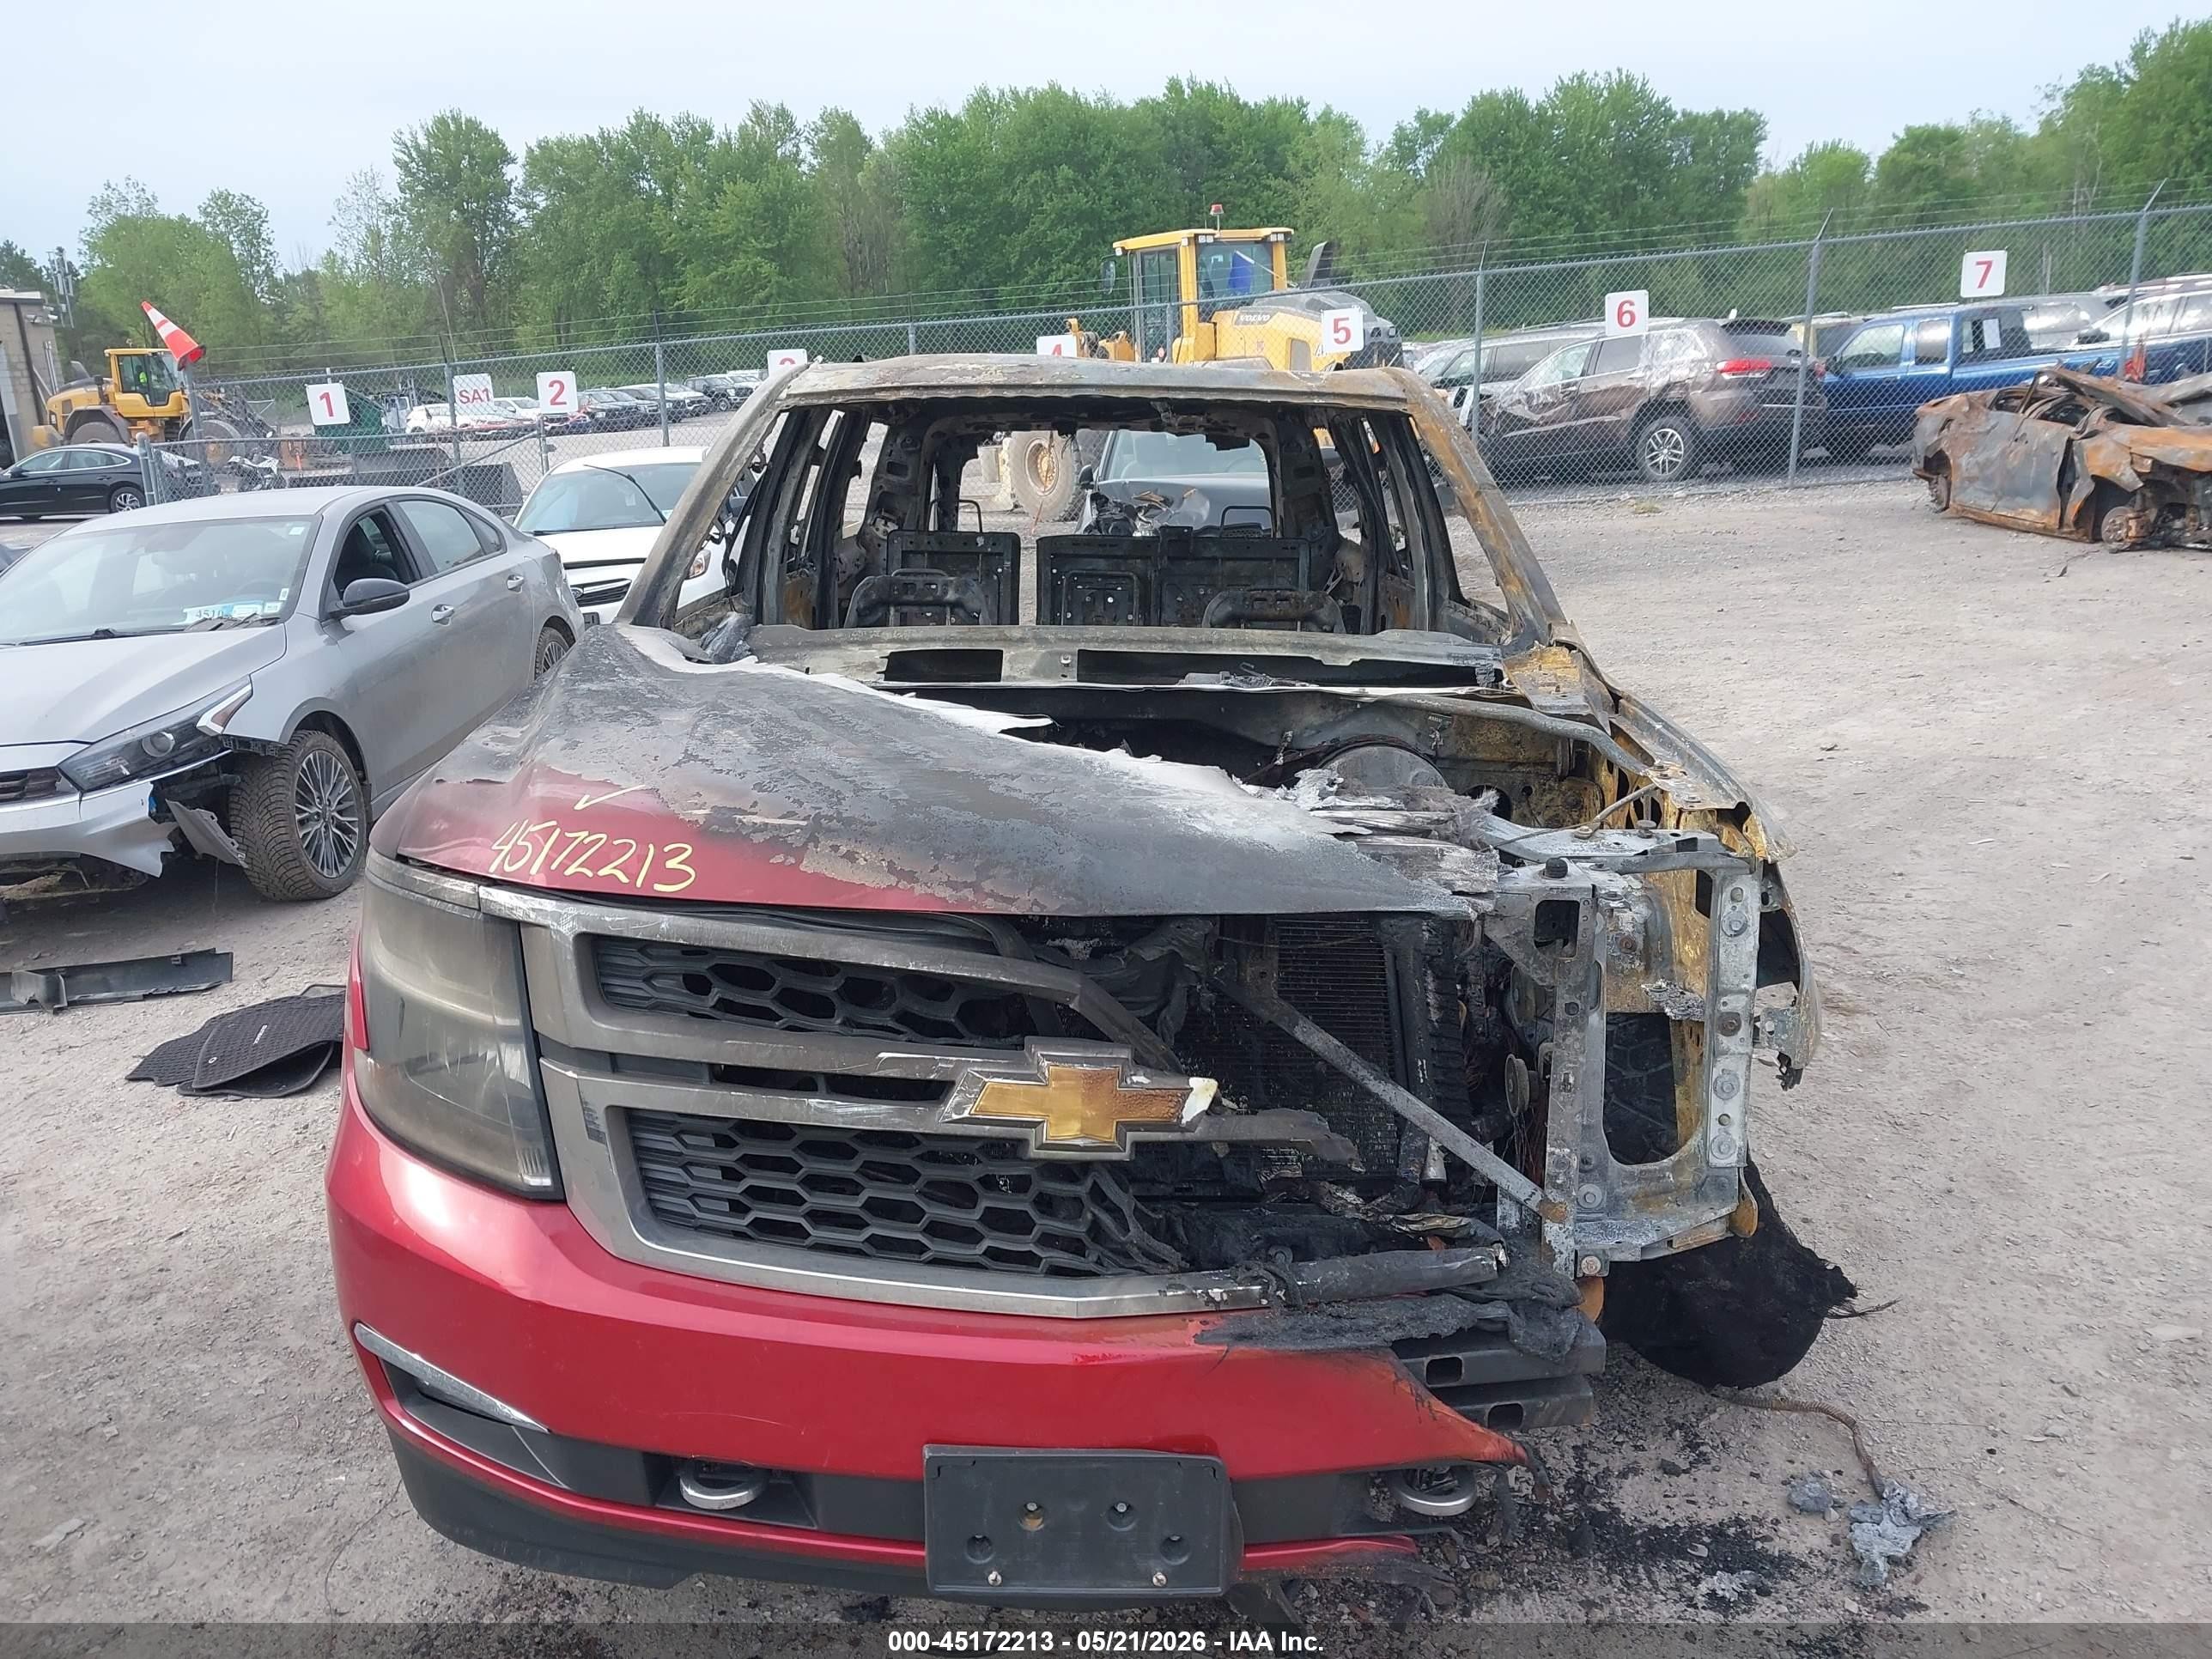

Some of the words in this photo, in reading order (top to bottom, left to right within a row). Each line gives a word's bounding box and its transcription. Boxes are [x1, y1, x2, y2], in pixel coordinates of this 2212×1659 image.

[1975, 260, 1994, 289] 7
[1616, 300, 1637, 328] 6
[1333, 317, 1352, 345] 5
[319, 392, 335, 417] 1
[459, 388, 492, 404] SA1
[548, 380, 568, 406] 2
[490, 819, 696, 892] 45172213
